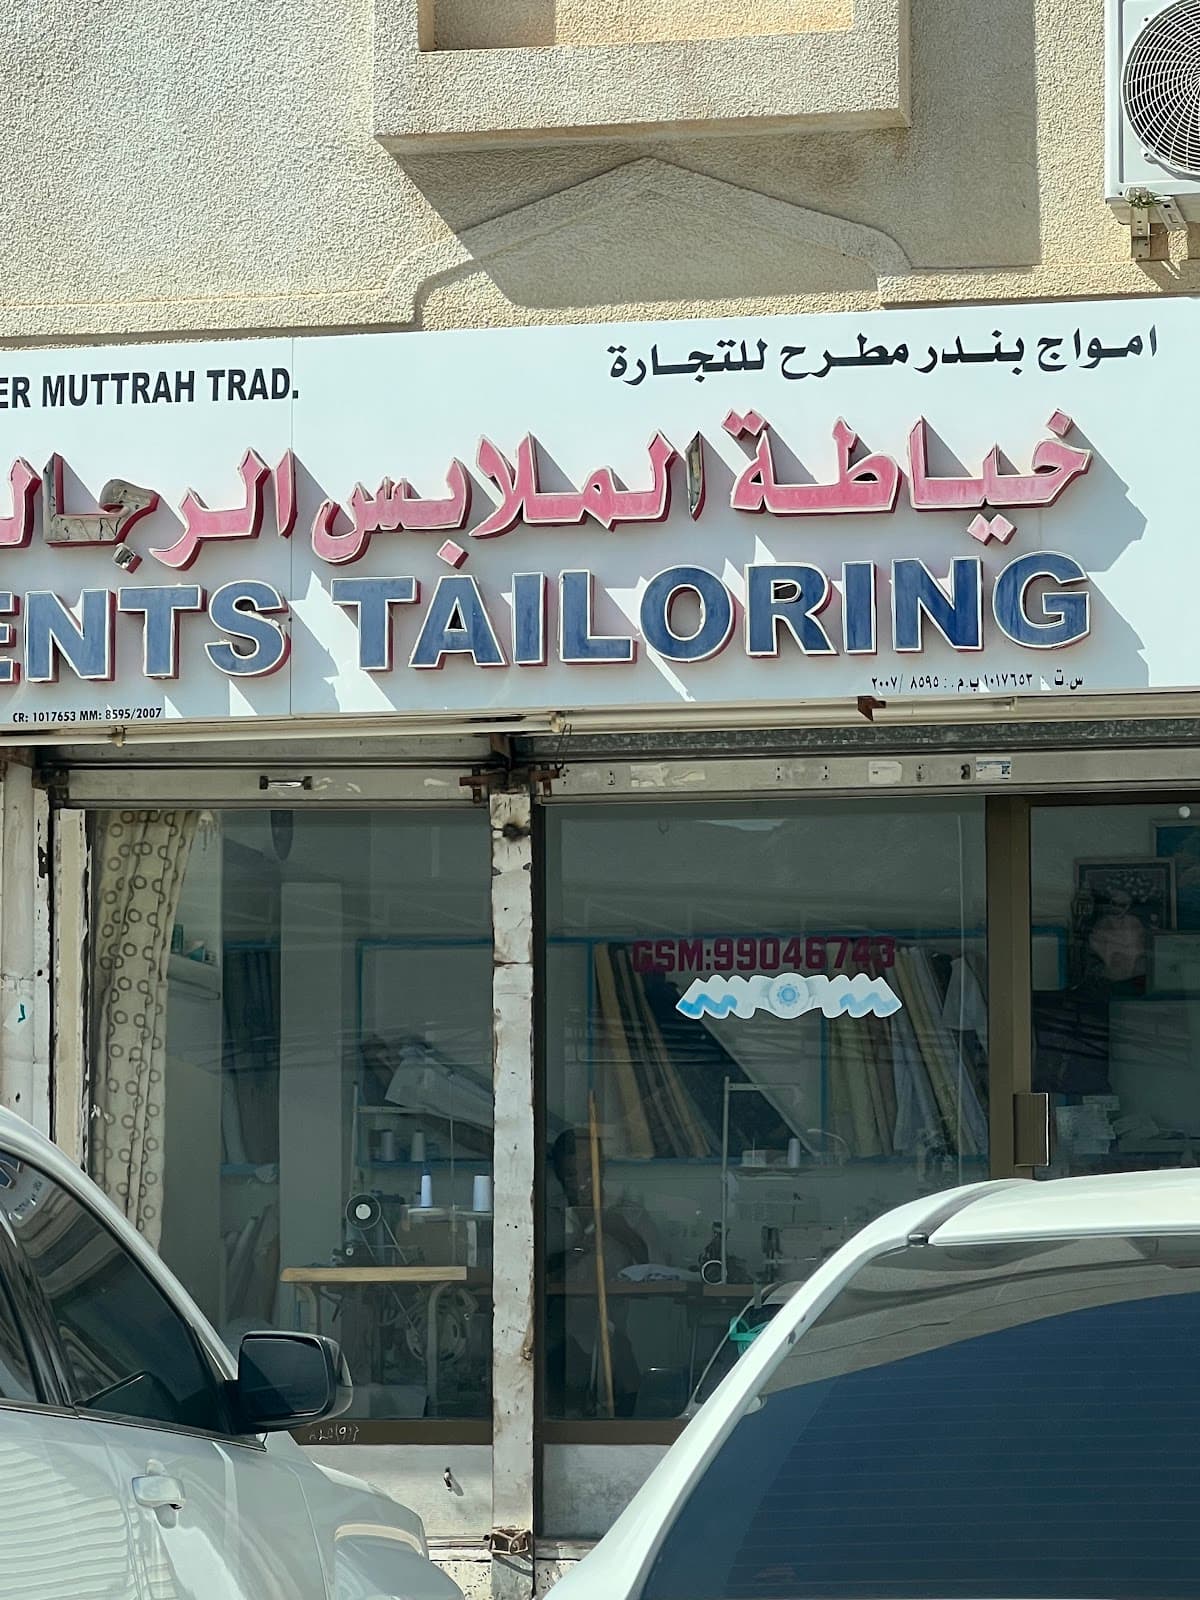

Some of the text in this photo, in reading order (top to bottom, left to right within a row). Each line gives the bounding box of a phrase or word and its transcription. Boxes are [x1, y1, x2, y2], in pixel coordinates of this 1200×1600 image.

[42, 371, 195, 408] MUTTRAH
[207, 367, 299, 401] TRAD.
[609, 324, 1157, 386] امواج بندر مطرح للتجارة
[311, 430, 705, 568] الملابس
[731, 408, 1092, 545] خياطة
[332, 551, 1092, 671] TAILORING
[12, 708, 162, 723] CR: 1017653 MM: 8595/2007
